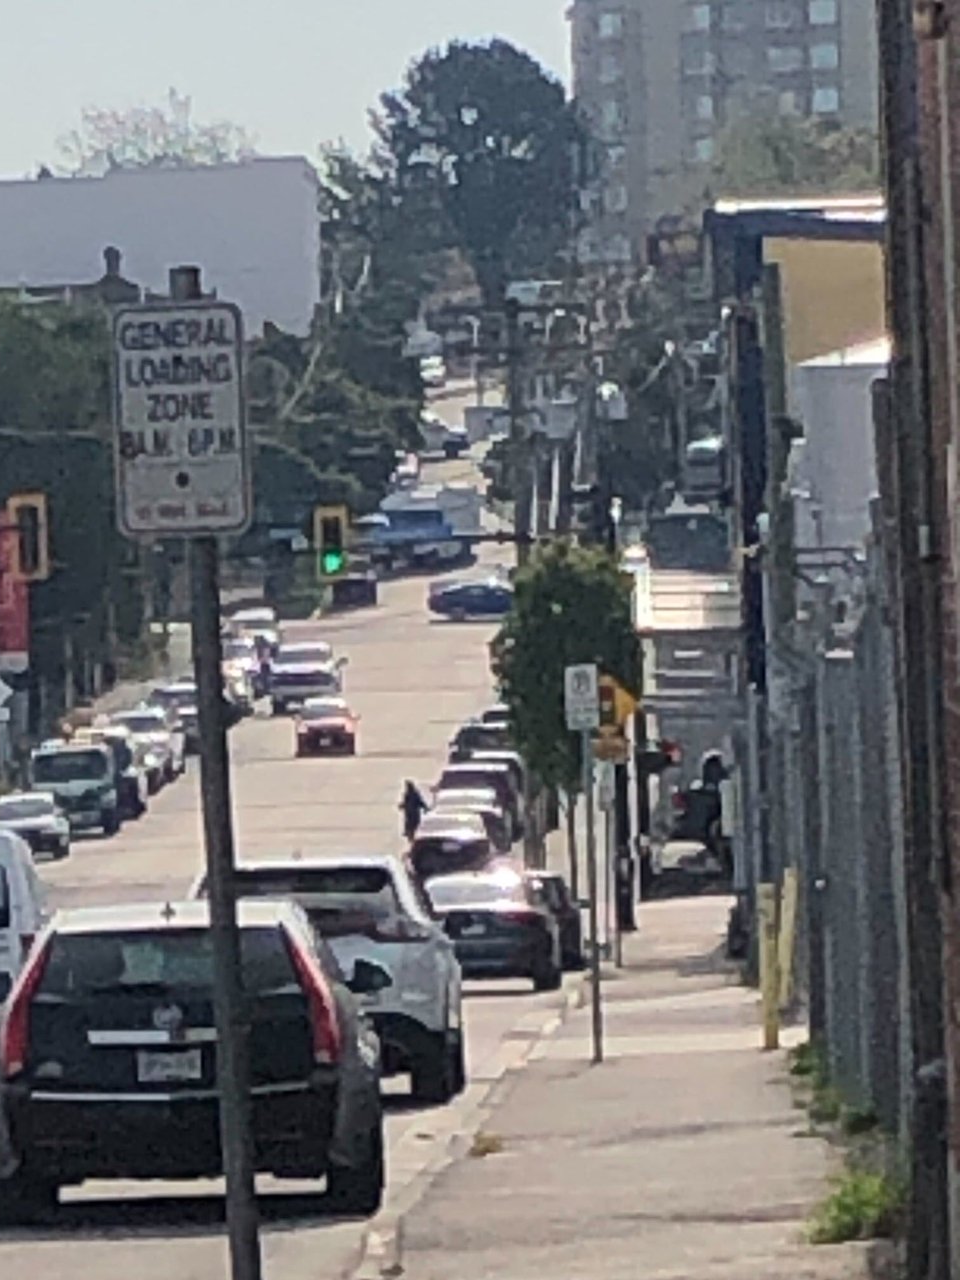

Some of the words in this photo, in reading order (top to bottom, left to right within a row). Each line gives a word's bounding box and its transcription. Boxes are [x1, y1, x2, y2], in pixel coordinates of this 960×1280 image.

[121, 318, 232, 349] GENERAL
[125, 354, 232, 386] LOADING
[147, 393, 214, 421] ZONE
